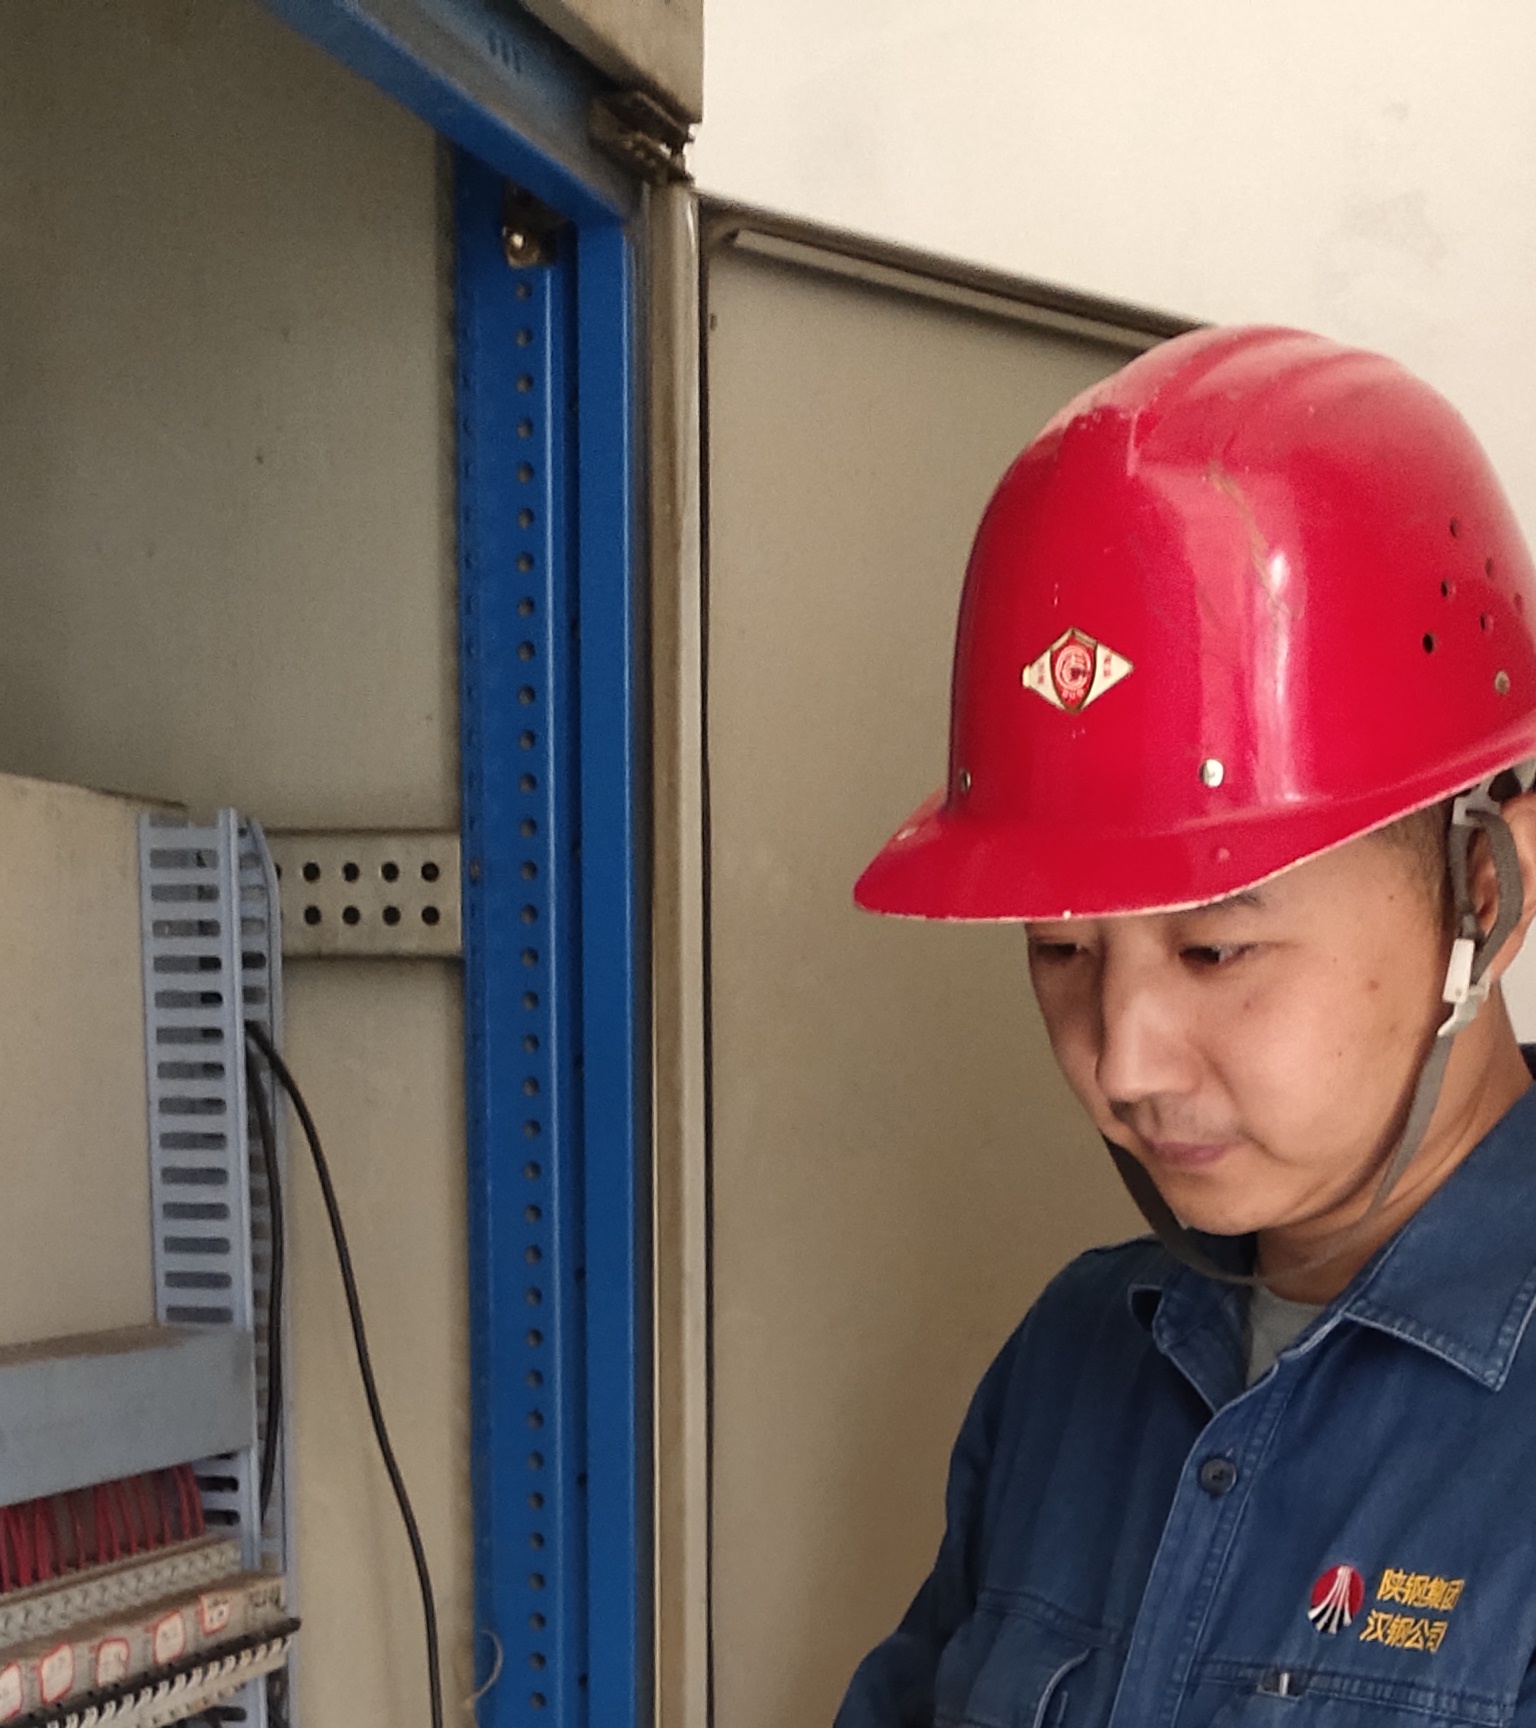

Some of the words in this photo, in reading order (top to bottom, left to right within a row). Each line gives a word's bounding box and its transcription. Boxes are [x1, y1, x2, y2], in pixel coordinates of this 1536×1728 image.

[1376, 1568, 1465, 1611] 陕钢集团
[1359, 1608, 1448, 1653] 汉钢公司
